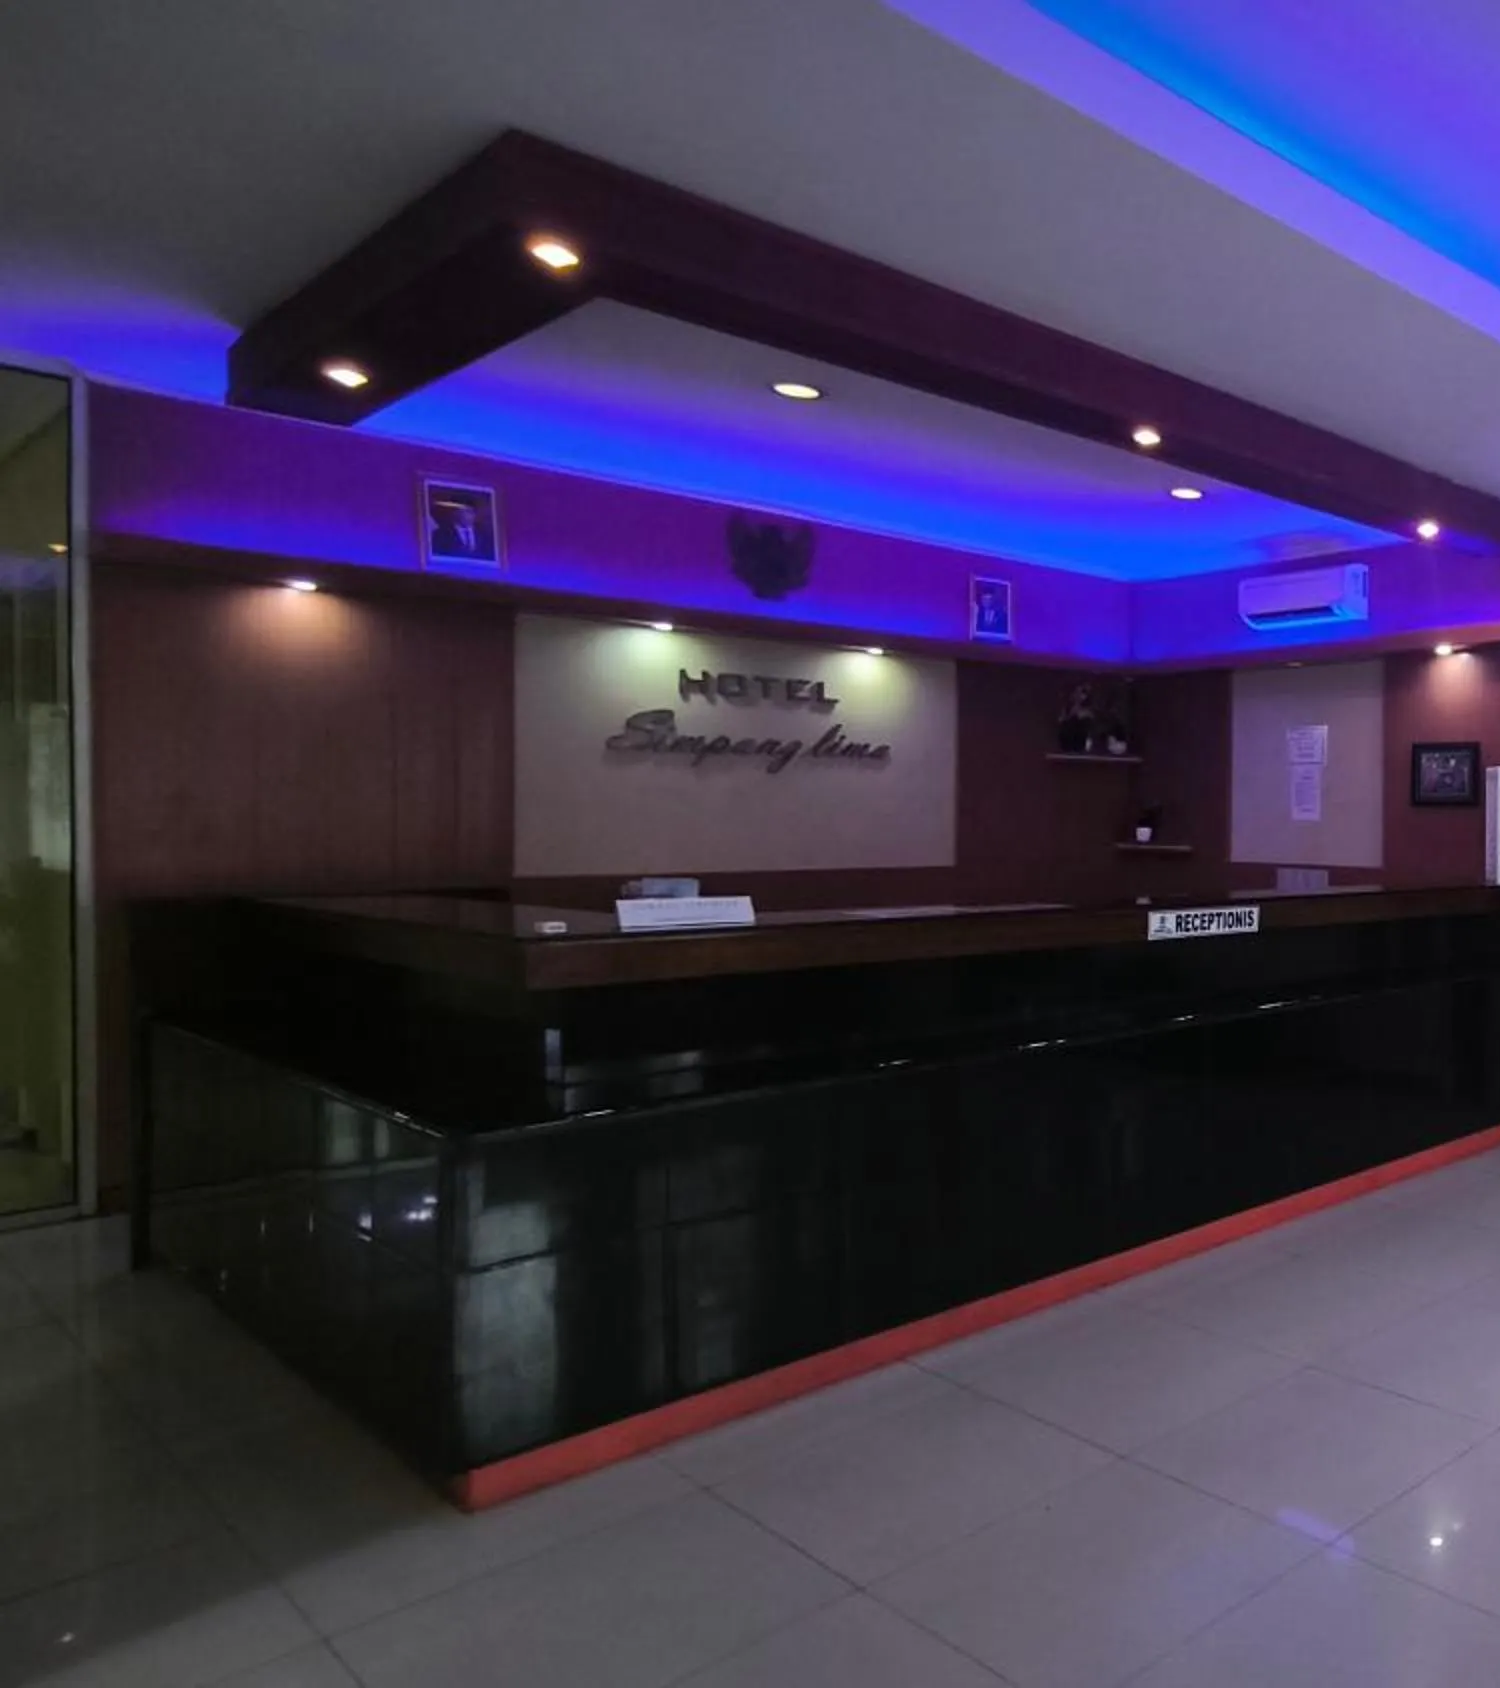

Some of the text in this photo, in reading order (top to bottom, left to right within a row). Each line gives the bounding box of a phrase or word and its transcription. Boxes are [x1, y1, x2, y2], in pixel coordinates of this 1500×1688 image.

[679, 669, 839, 705] HOTEL
[605, 709, 802, 774] Simpang
[1175, 910, 1255, 933] RECEPTIONIS
